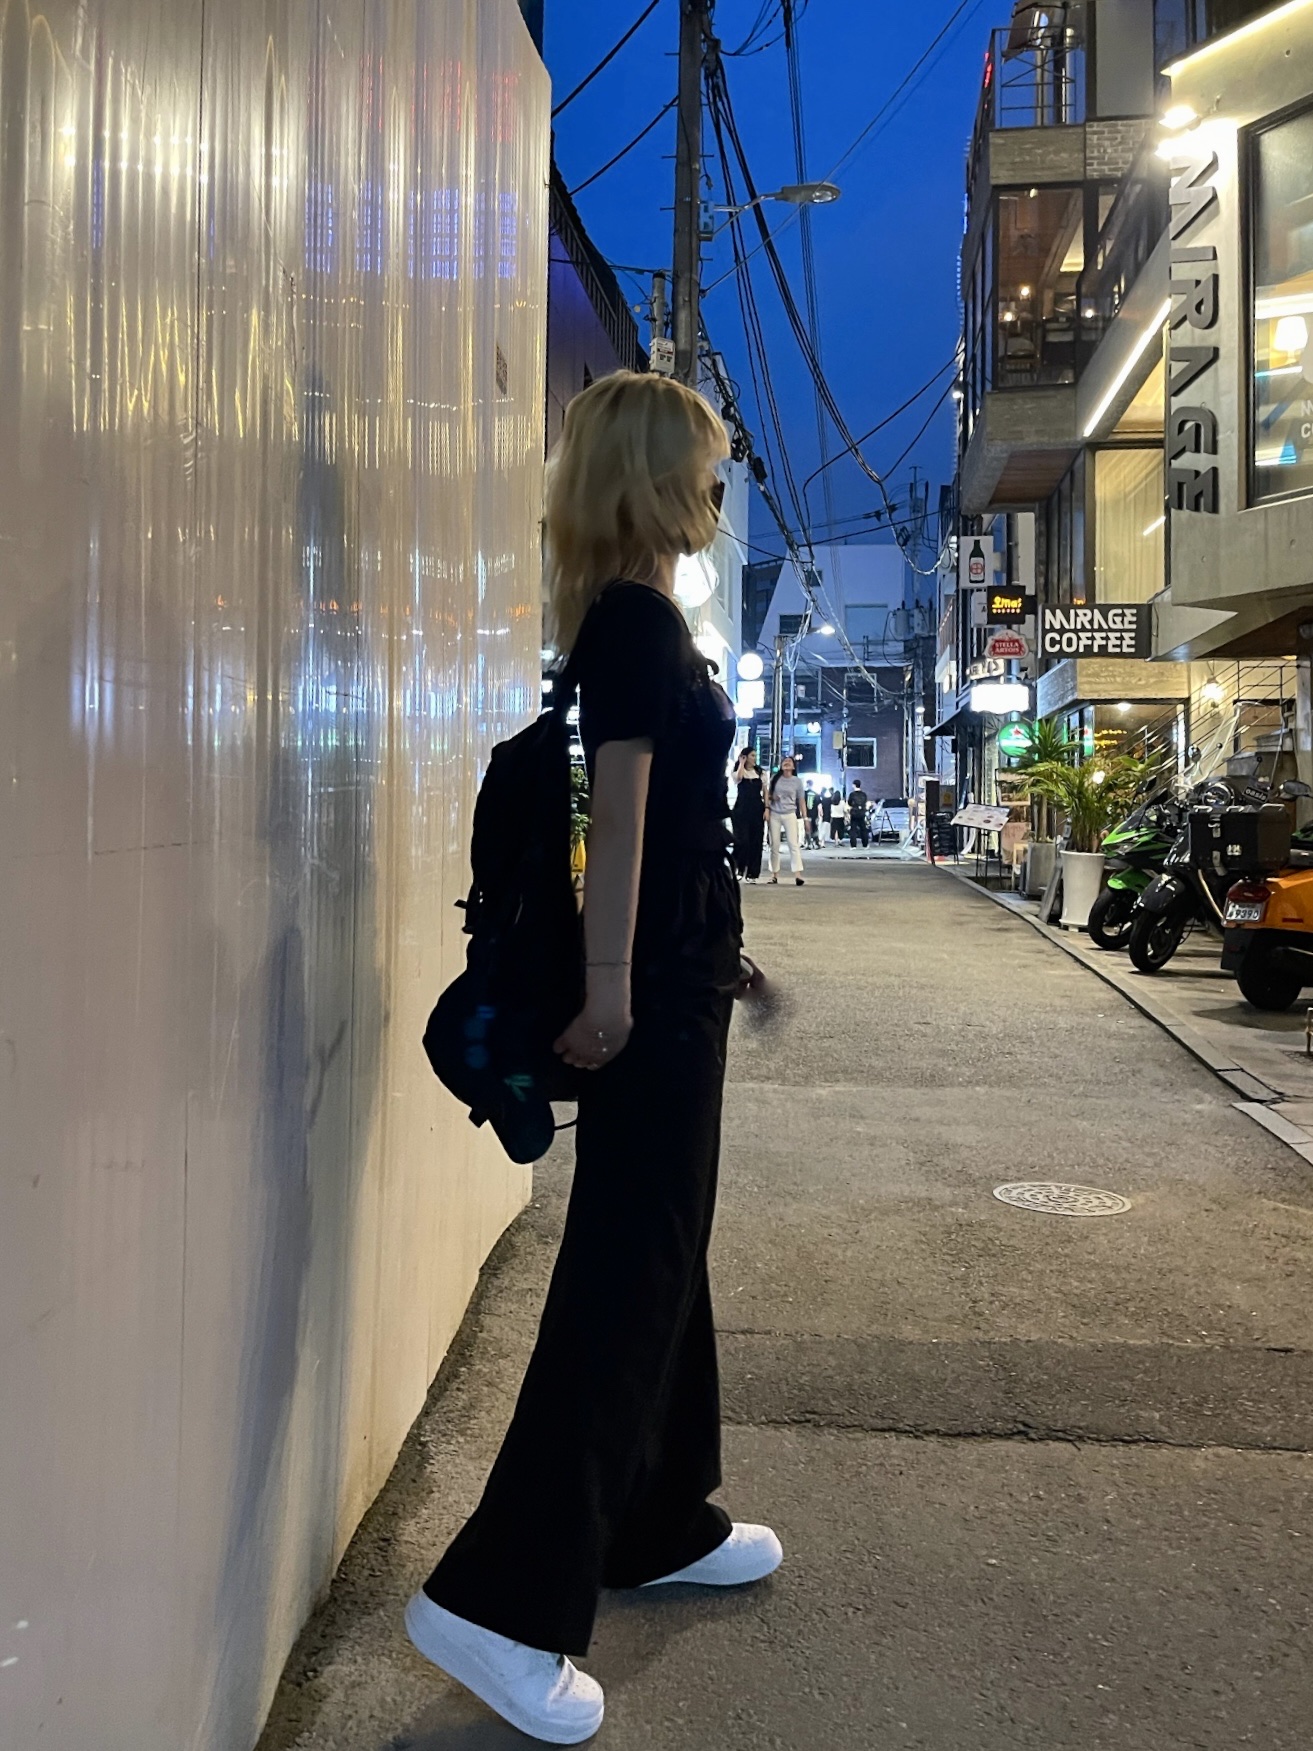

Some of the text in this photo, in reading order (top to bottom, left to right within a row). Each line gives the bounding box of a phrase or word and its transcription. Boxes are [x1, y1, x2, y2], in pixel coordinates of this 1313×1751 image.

[1169, 150, 1220, 514] MIRAGE
[1044, 608, 1137, 630] MIRAGE
[1044, 631, 1136, 653] COFFEE
